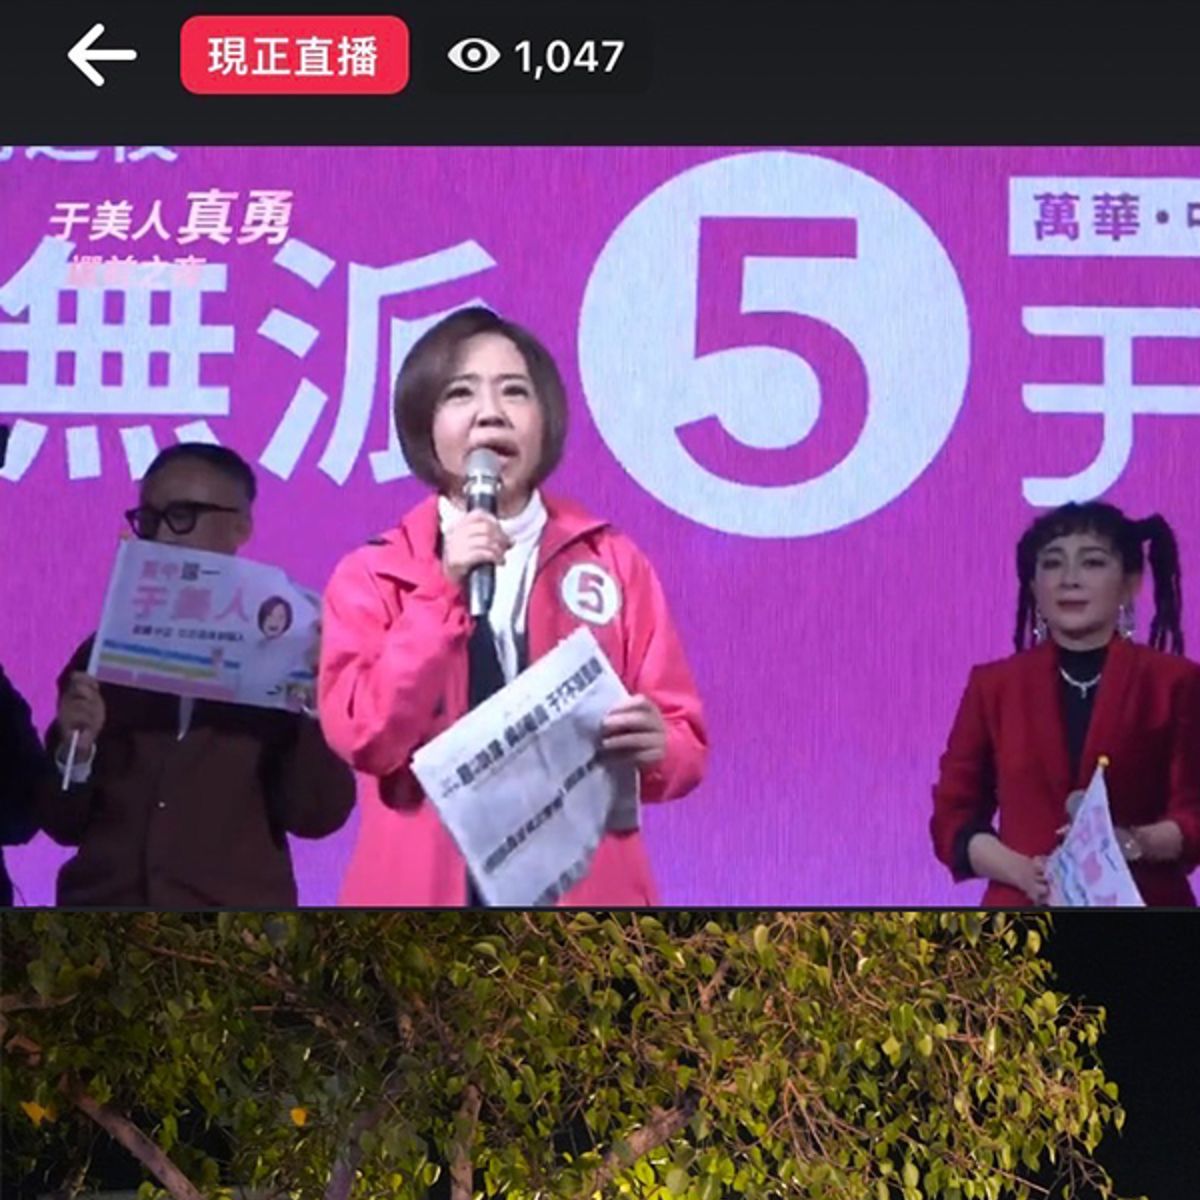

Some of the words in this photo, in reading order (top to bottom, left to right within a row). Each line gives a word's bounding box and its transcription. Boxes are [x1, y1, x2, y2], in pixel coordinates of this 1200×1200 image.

[208, 36, 379, 77] 現正直播
[515, 40, 625, 80] 1,047
[674, 216, 870, 488] 5
[577, 570, 605, 615] 5
